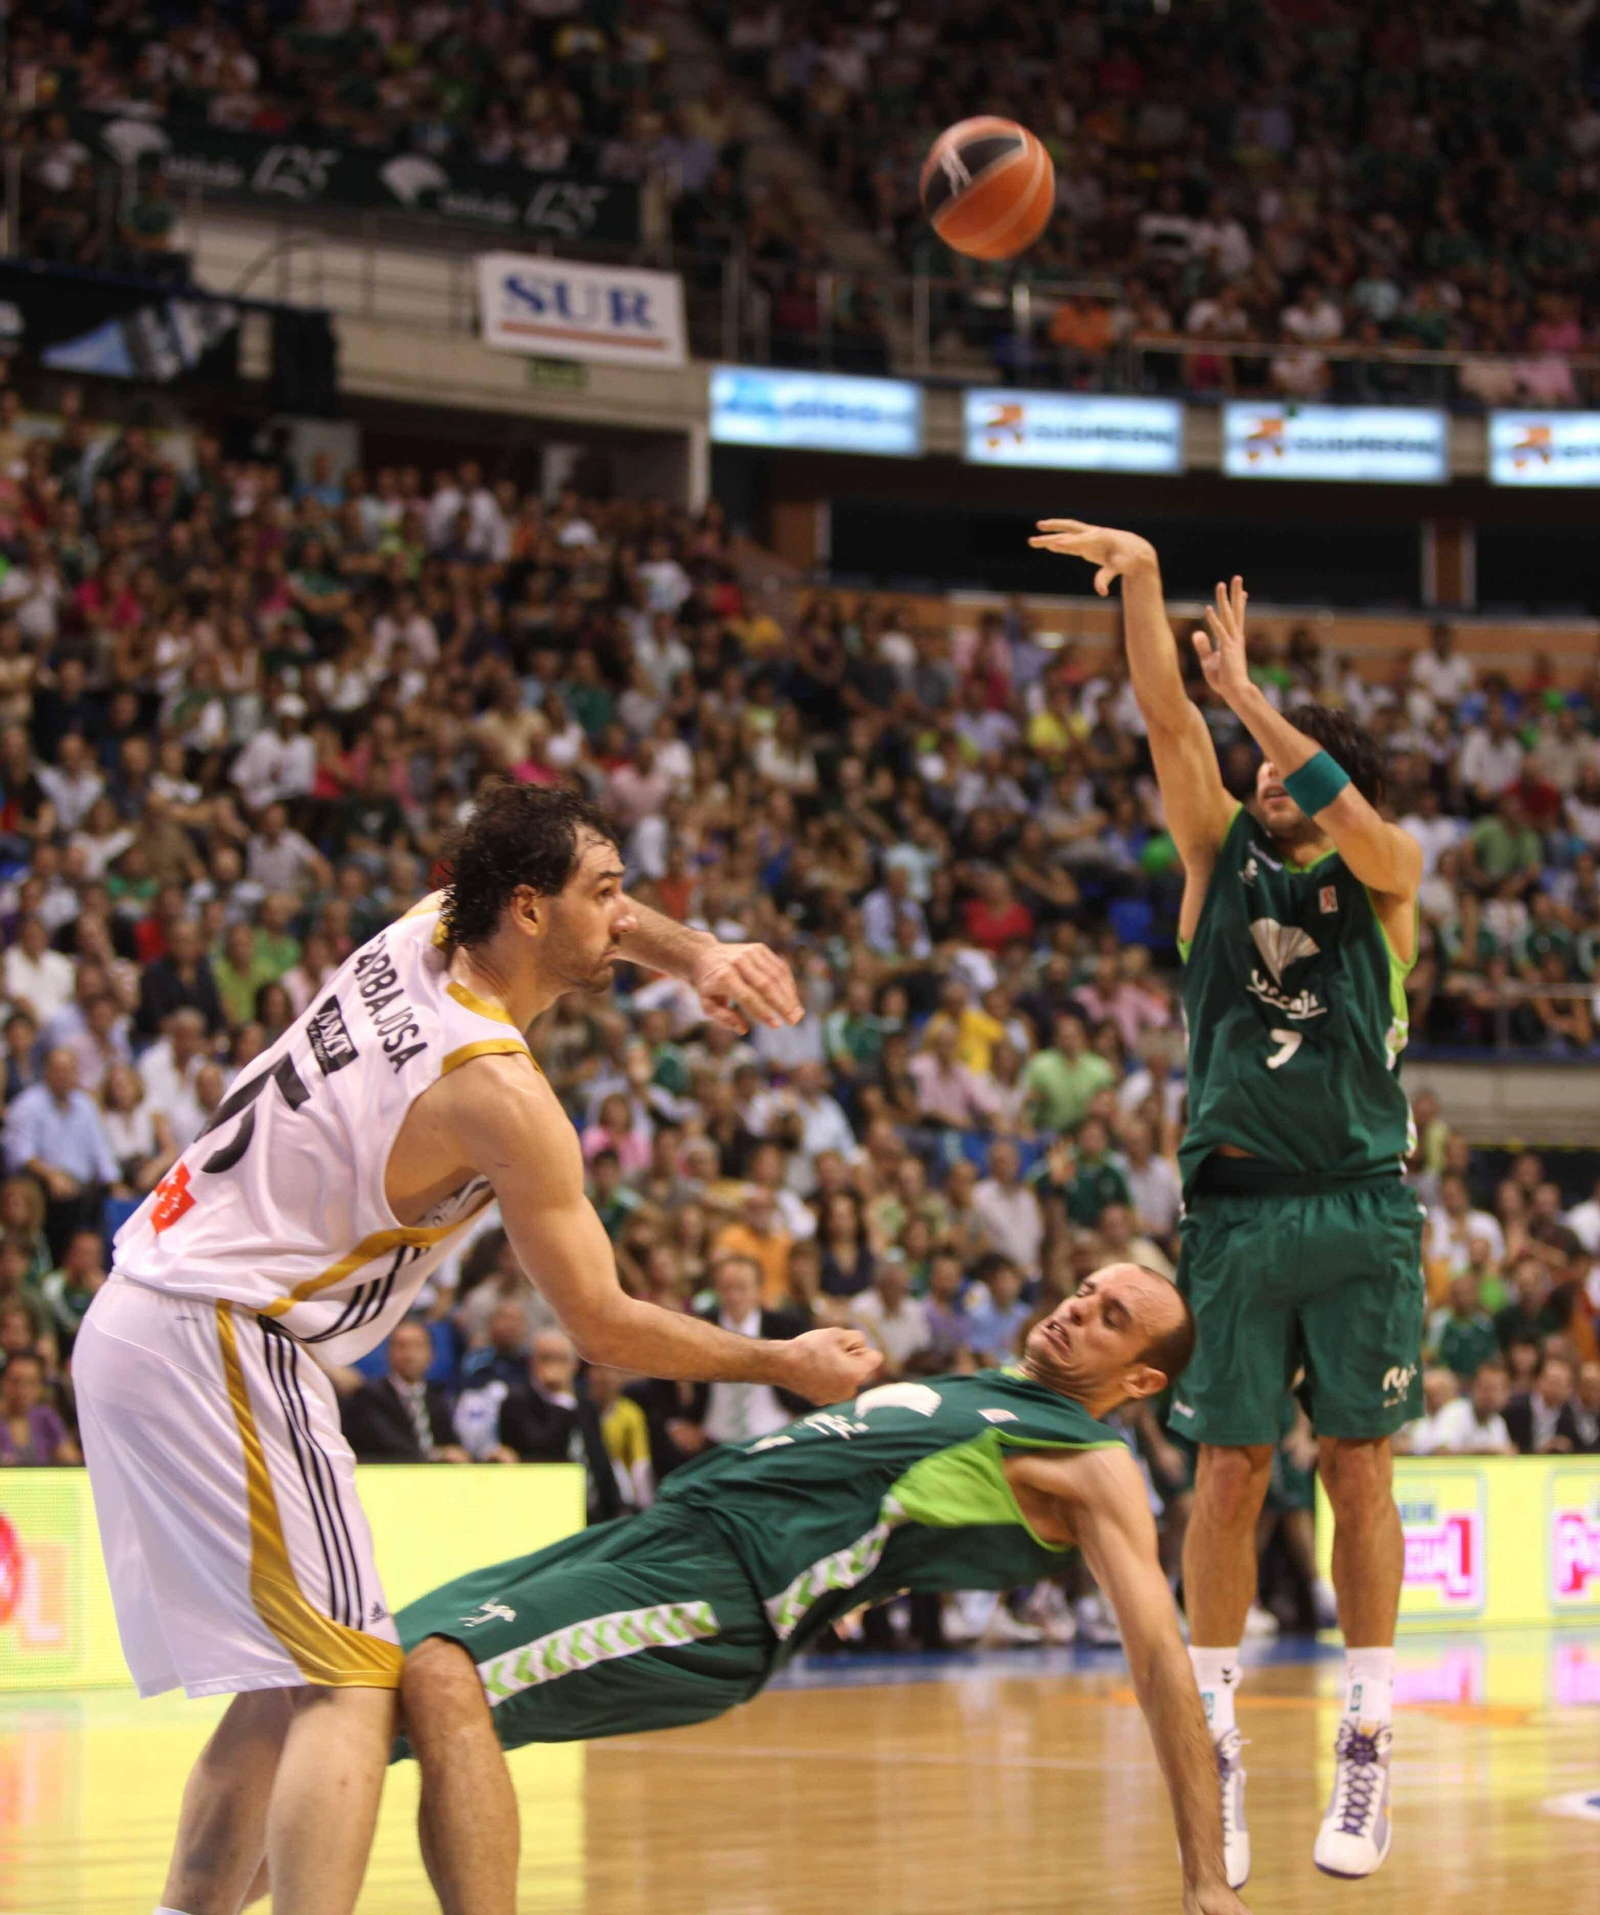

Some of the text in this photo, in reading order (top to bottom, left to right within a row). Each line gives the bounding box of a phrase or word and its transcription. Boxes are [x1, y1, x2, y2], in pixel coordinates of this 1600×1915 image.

[504, 273, 655, 330] SUR
[354, 933, 429, 1075] ARBAJOSA
[314, 1007, 353, 1059] MMT
[1266, 1028, 1304, 1070] 7
